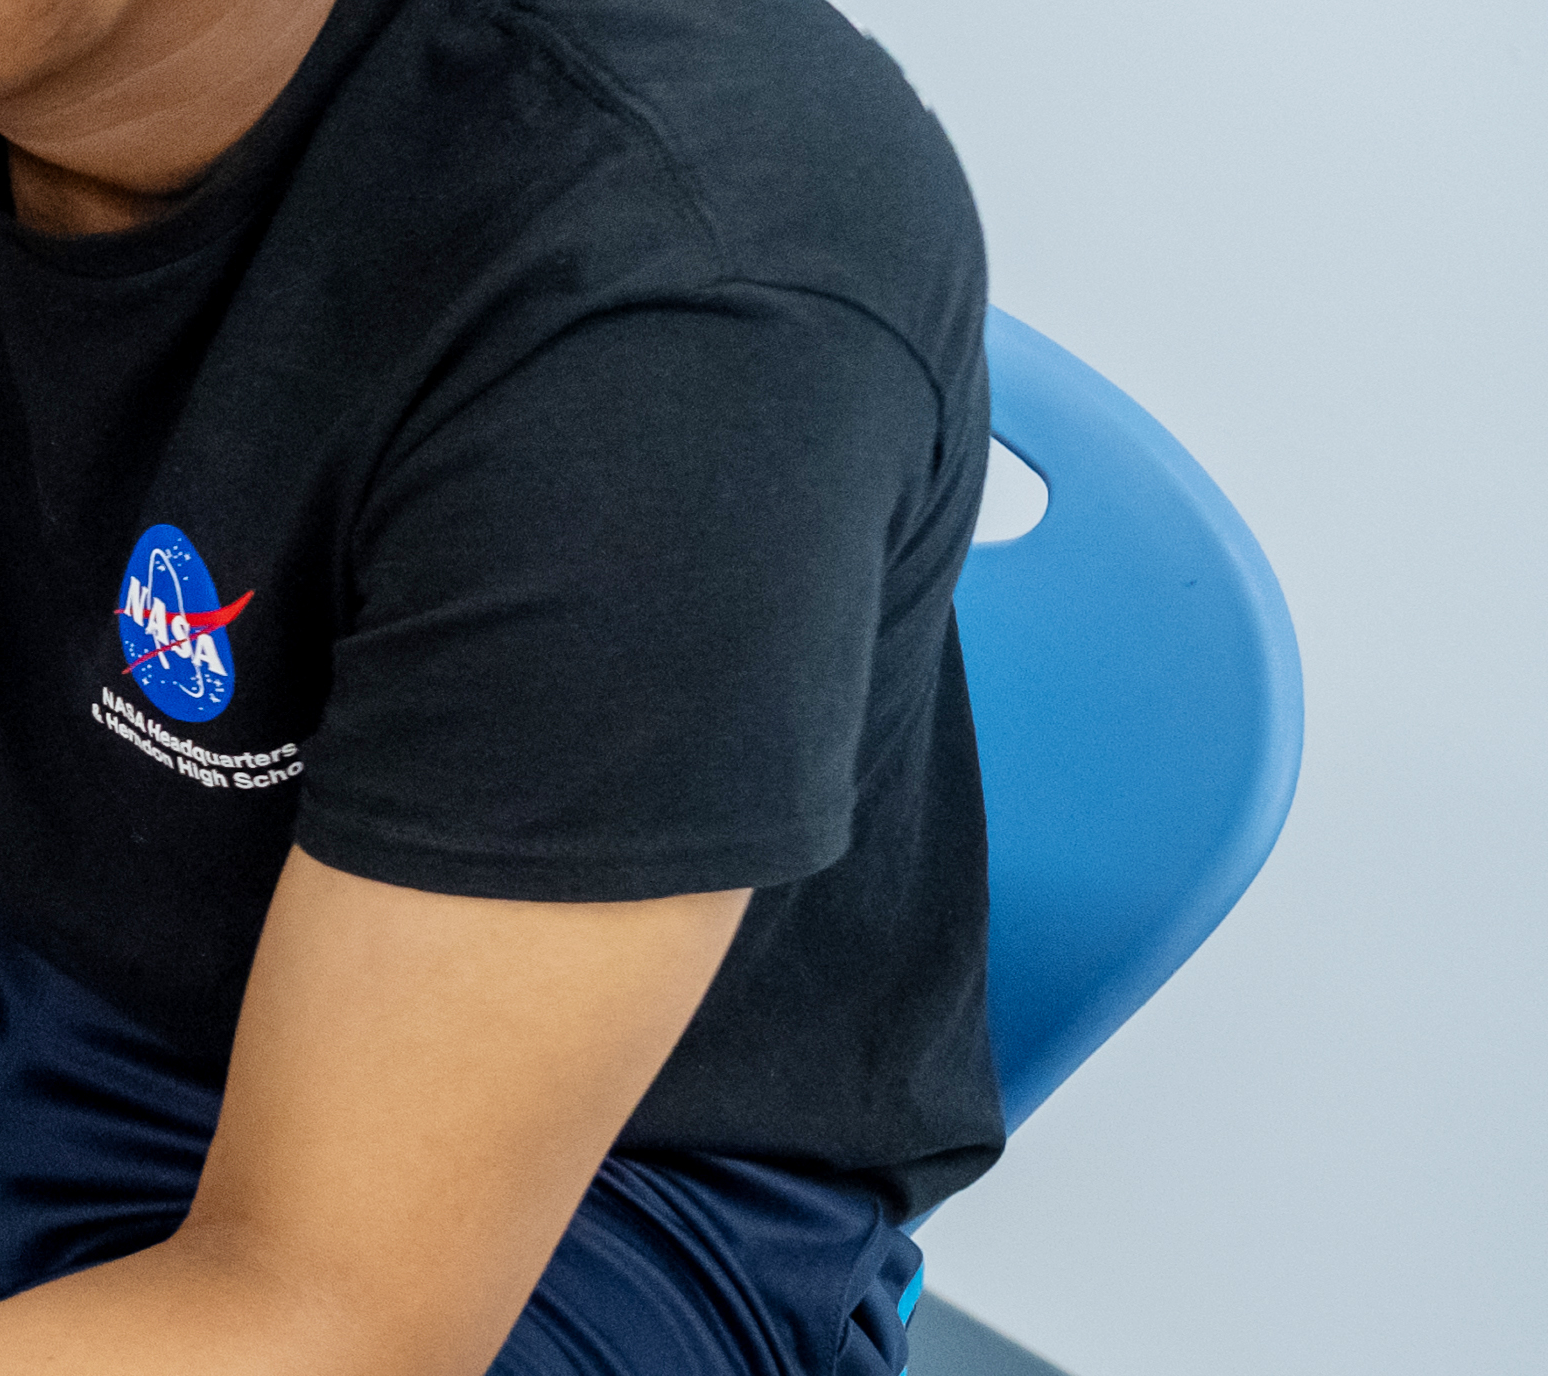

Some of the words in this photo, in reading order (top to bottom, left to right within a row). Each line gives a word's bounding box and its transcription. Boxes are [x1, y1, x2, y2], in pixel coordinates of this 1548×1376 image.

[124, 575, 229, 677] NASA
[102, 686, 147, 733] NASA
[147, 719, 298, 769] Headquarters
[176, 756, 230, 788] High
